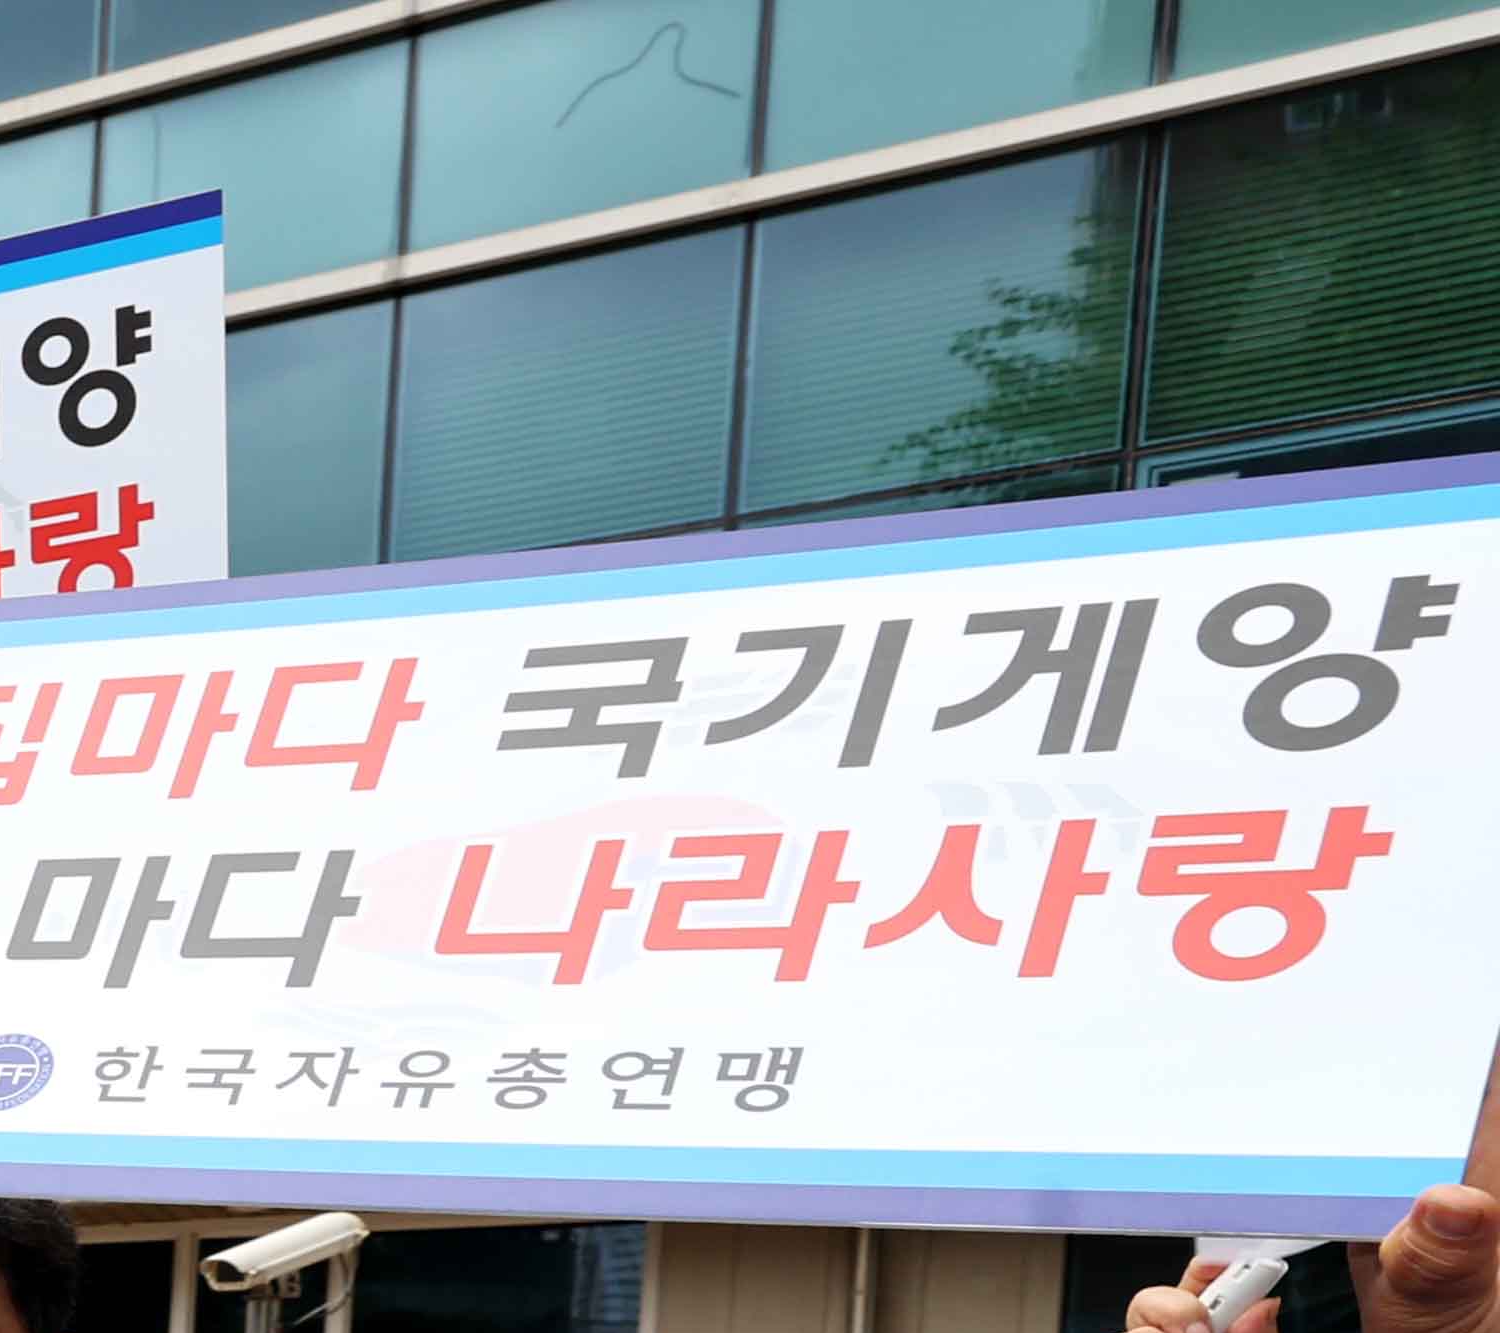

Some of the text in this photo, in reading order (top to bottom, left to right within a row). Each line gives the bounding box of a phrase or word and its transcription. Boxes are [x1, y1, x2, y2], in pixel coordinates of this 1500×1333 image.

[496, 574, 1460, 777] 국기게양
[434, 804, 1393, 983] 나라사랑
[92, 1042, 804, 1112] 한국자유총연맹
